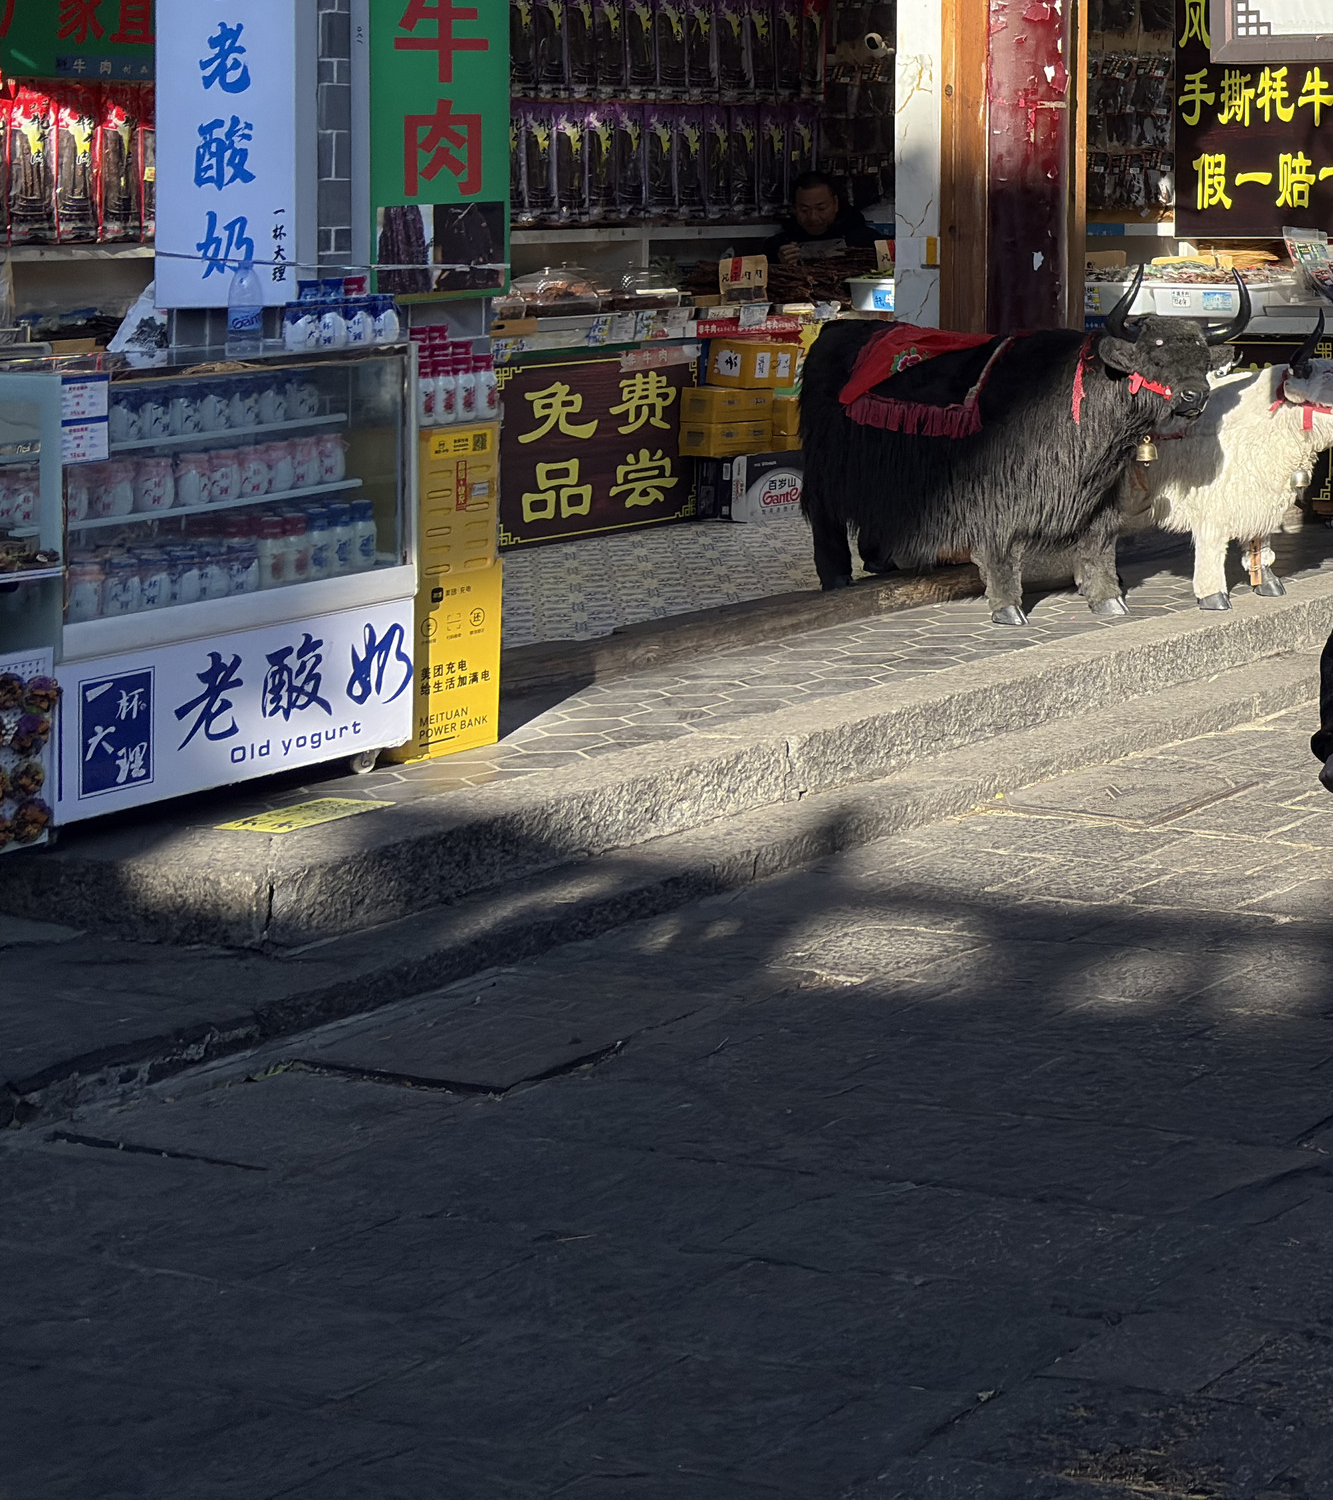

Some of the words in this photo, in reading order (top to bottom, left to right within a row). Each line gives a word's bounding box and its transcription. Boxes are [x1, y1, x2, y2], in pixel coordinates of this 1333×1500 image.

[272, 208, 287, 282] 一杯大理
[516, 371, 678, 444] 免费
[521, 449, 679, 524] 品尝
[763, 487, 803, 506] Gante
[769, 477, 797, 491] 百岁山
[176, 623, 414, 752] 老酸奶
[420, 659, 469, 683] 美团充电
[420, 669, 491, 696] 给生活加满电
[85, 681, 148, 785] 一杯大理
[419, 707, 469, 727] MEITUAN
[419, 722, 458, 740] POWER
[460, 713, 488, 730] BANK
[229, 738, 273, 765] Old
[280, 721, 363, 758] yogurt
